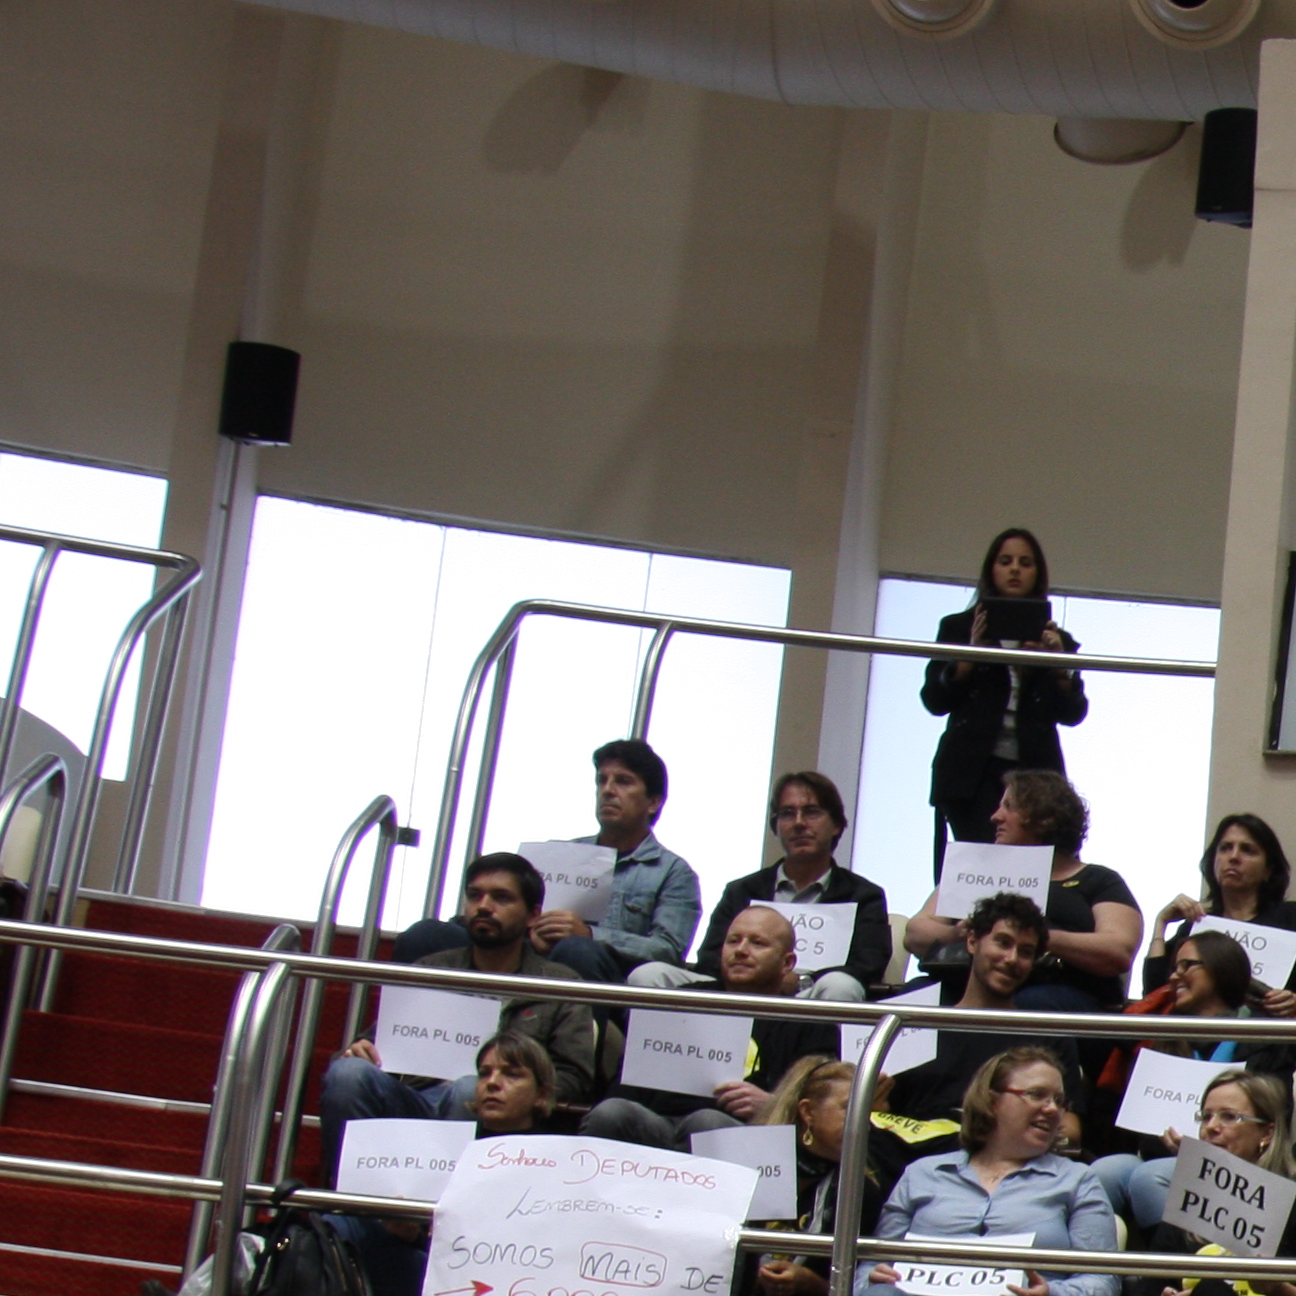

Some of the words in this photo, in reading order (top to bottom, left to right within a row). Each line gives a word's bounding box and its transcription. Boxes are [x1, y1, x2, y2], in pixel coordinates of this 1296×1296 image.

[556, 873, 571, 885] PL
[576, 876, 598, 888] 005
[957, 873, 994, 886] FORA
[999, 877, 1014, 888] PL
[1018, 877, 1038, 888] 005
[813, 941, 824, 955] 5
[1251, 962, 1264, 976] 5
[392, 1024, 428, 1039] FORA
[433, 1029, 451, 1042] PL
[455, 1033, 480, 1047] 005
[643, 1038, 683, 1055] FORA
[687, 1045, 703, 1059] PL
[708, 1049, 732, 1063] 005
[1144, 1086, 1182, 1102] FORA
[356, 1157, 400, 1169] FORA
[404, 1157, 424, 1169] PL
[429, 1158, 456, 1172] 005
[563, 1149, 717, 1190] DEPUTADOS
[1200, 1157, 1266, 1210] FORA
[1181, 1189, 1226, 1231] PLC
[1232, 1218, 1266, 1249] 05
[447, 1235, 555, 1269] SOMOS
[681, 1267, 723, 1294] DE
[904, 1267, 962, 1287] PLC
[970, 1267, 1006, 1286] 05
